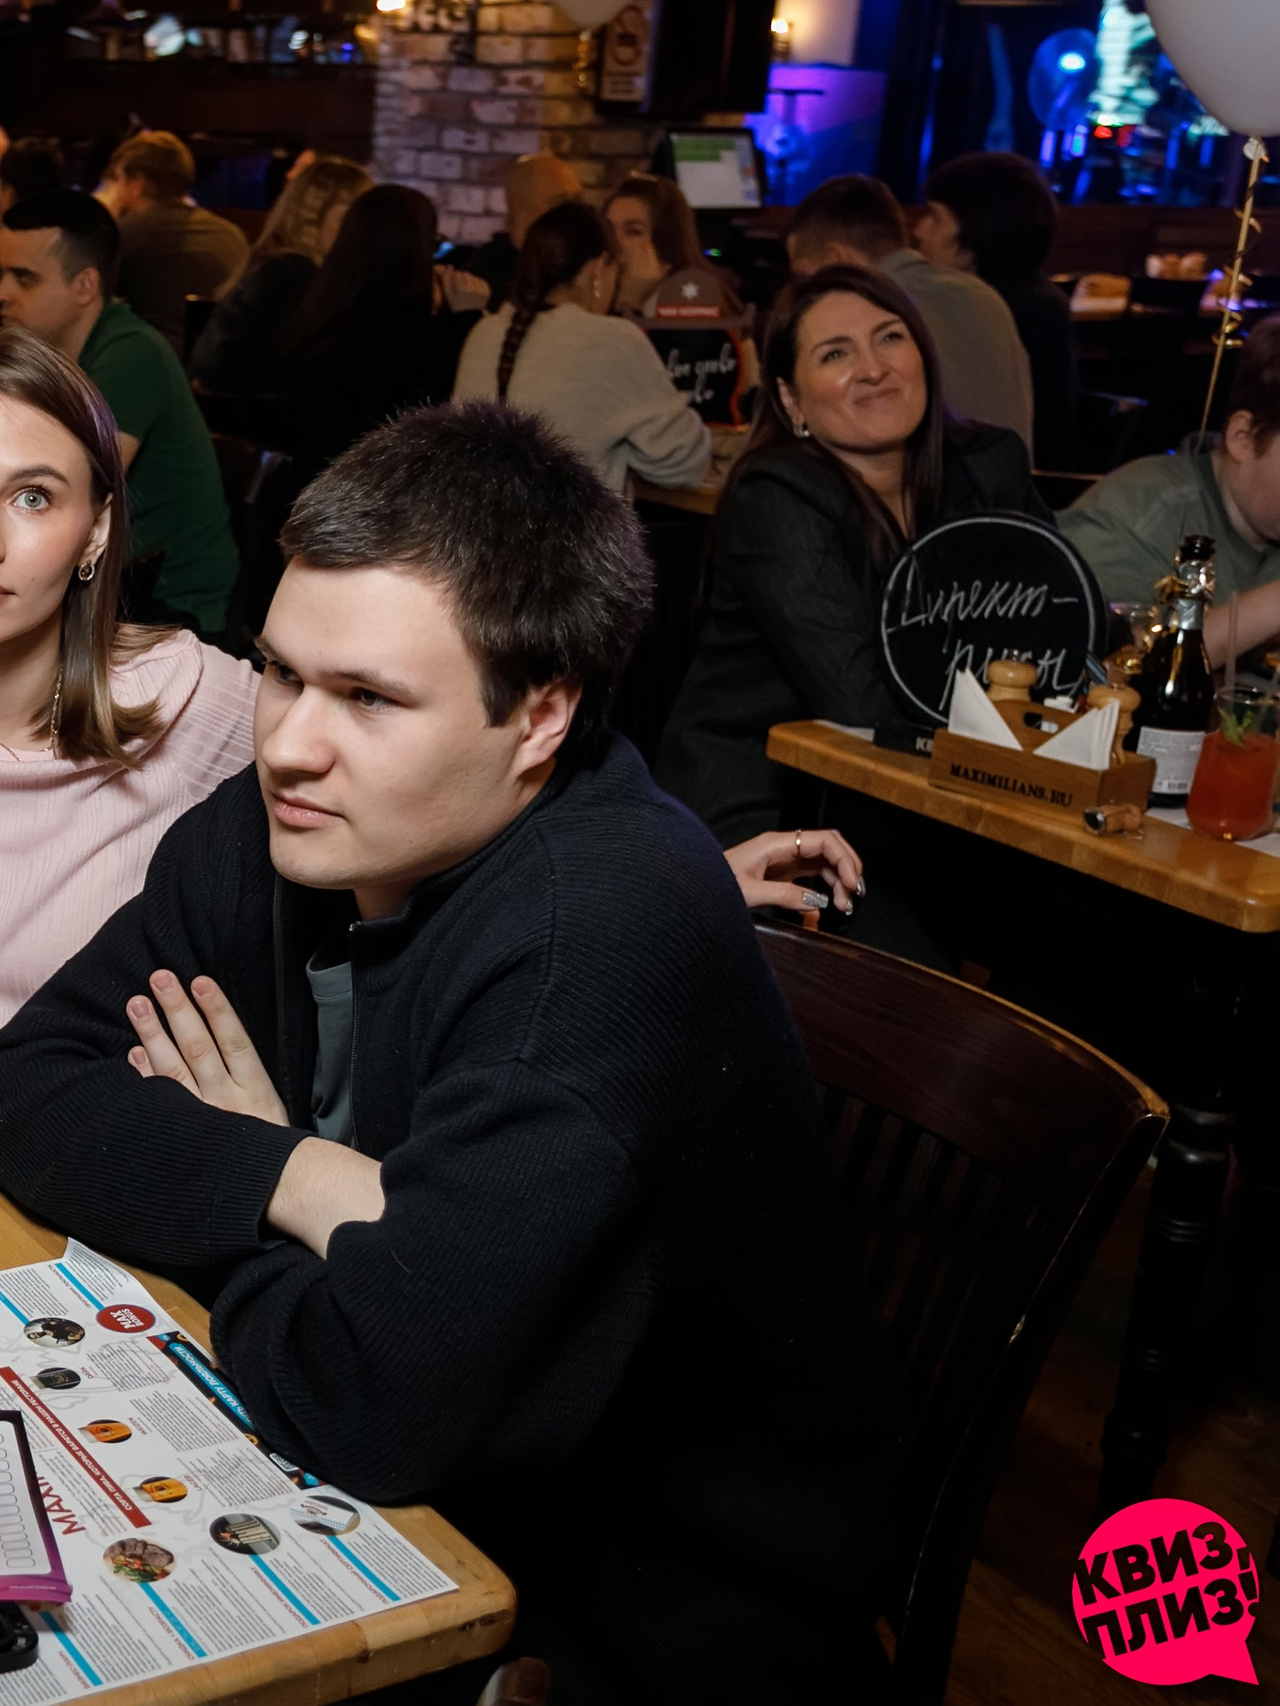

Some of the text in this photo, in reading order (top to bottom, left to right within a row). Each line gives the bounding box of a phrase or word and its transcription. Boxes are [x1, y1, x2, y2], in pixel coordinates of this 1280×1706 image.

[110, 1310, 138, 1330] MAX
[121, 1308, 144, 1327] BONUS
[174, 1345, 219, 1388] ЛОЯЛЬНОСТИ
[11, 1377, 38, 1406] РЕСТОРАНЕ
[217, 1383, 240, 1408] КАРТУ
[128, 1417, 147, 1435] WEIZEN
[55, 1427, 79, 1452] ВАРЯТСЯ
[75, 1449, 101, 1477] КОТОРЫЕ
[183, 1474, 203, 1492] LAGER
[112, 1490, 133, 1512] СОРТА
[320, 1540, 389, 1605] ПОДАРОЧНЫЙ СЕРТИФИКАТ
[283, 1604, 308, 1628] ПОДАРОК
